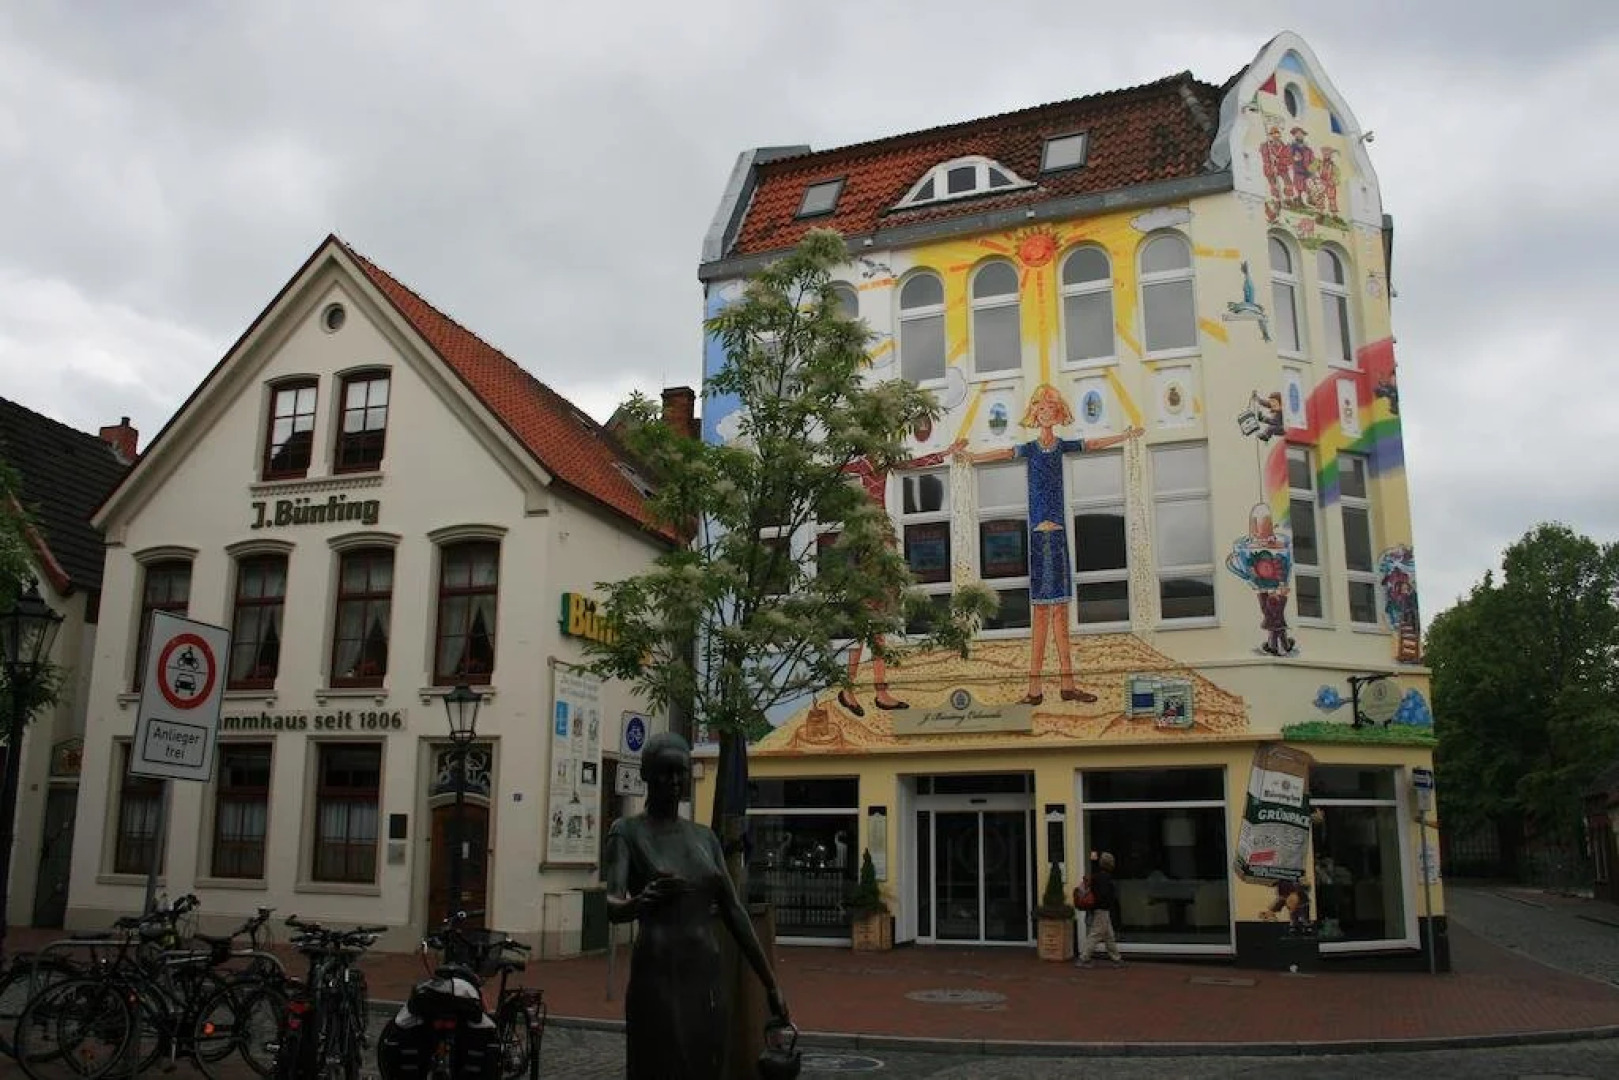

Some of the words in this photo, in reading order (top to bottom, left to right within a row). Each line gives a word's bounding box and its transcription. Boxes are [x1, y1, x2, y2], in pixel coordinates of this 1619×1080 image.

[218, 711, 307, 731] mmhaus
[315, 710, 352, 730] seit
[359, 711, 402, 730] 1806
[153, 726, 200, 745] Anlieger
[165, 746, 186, 759] frei
